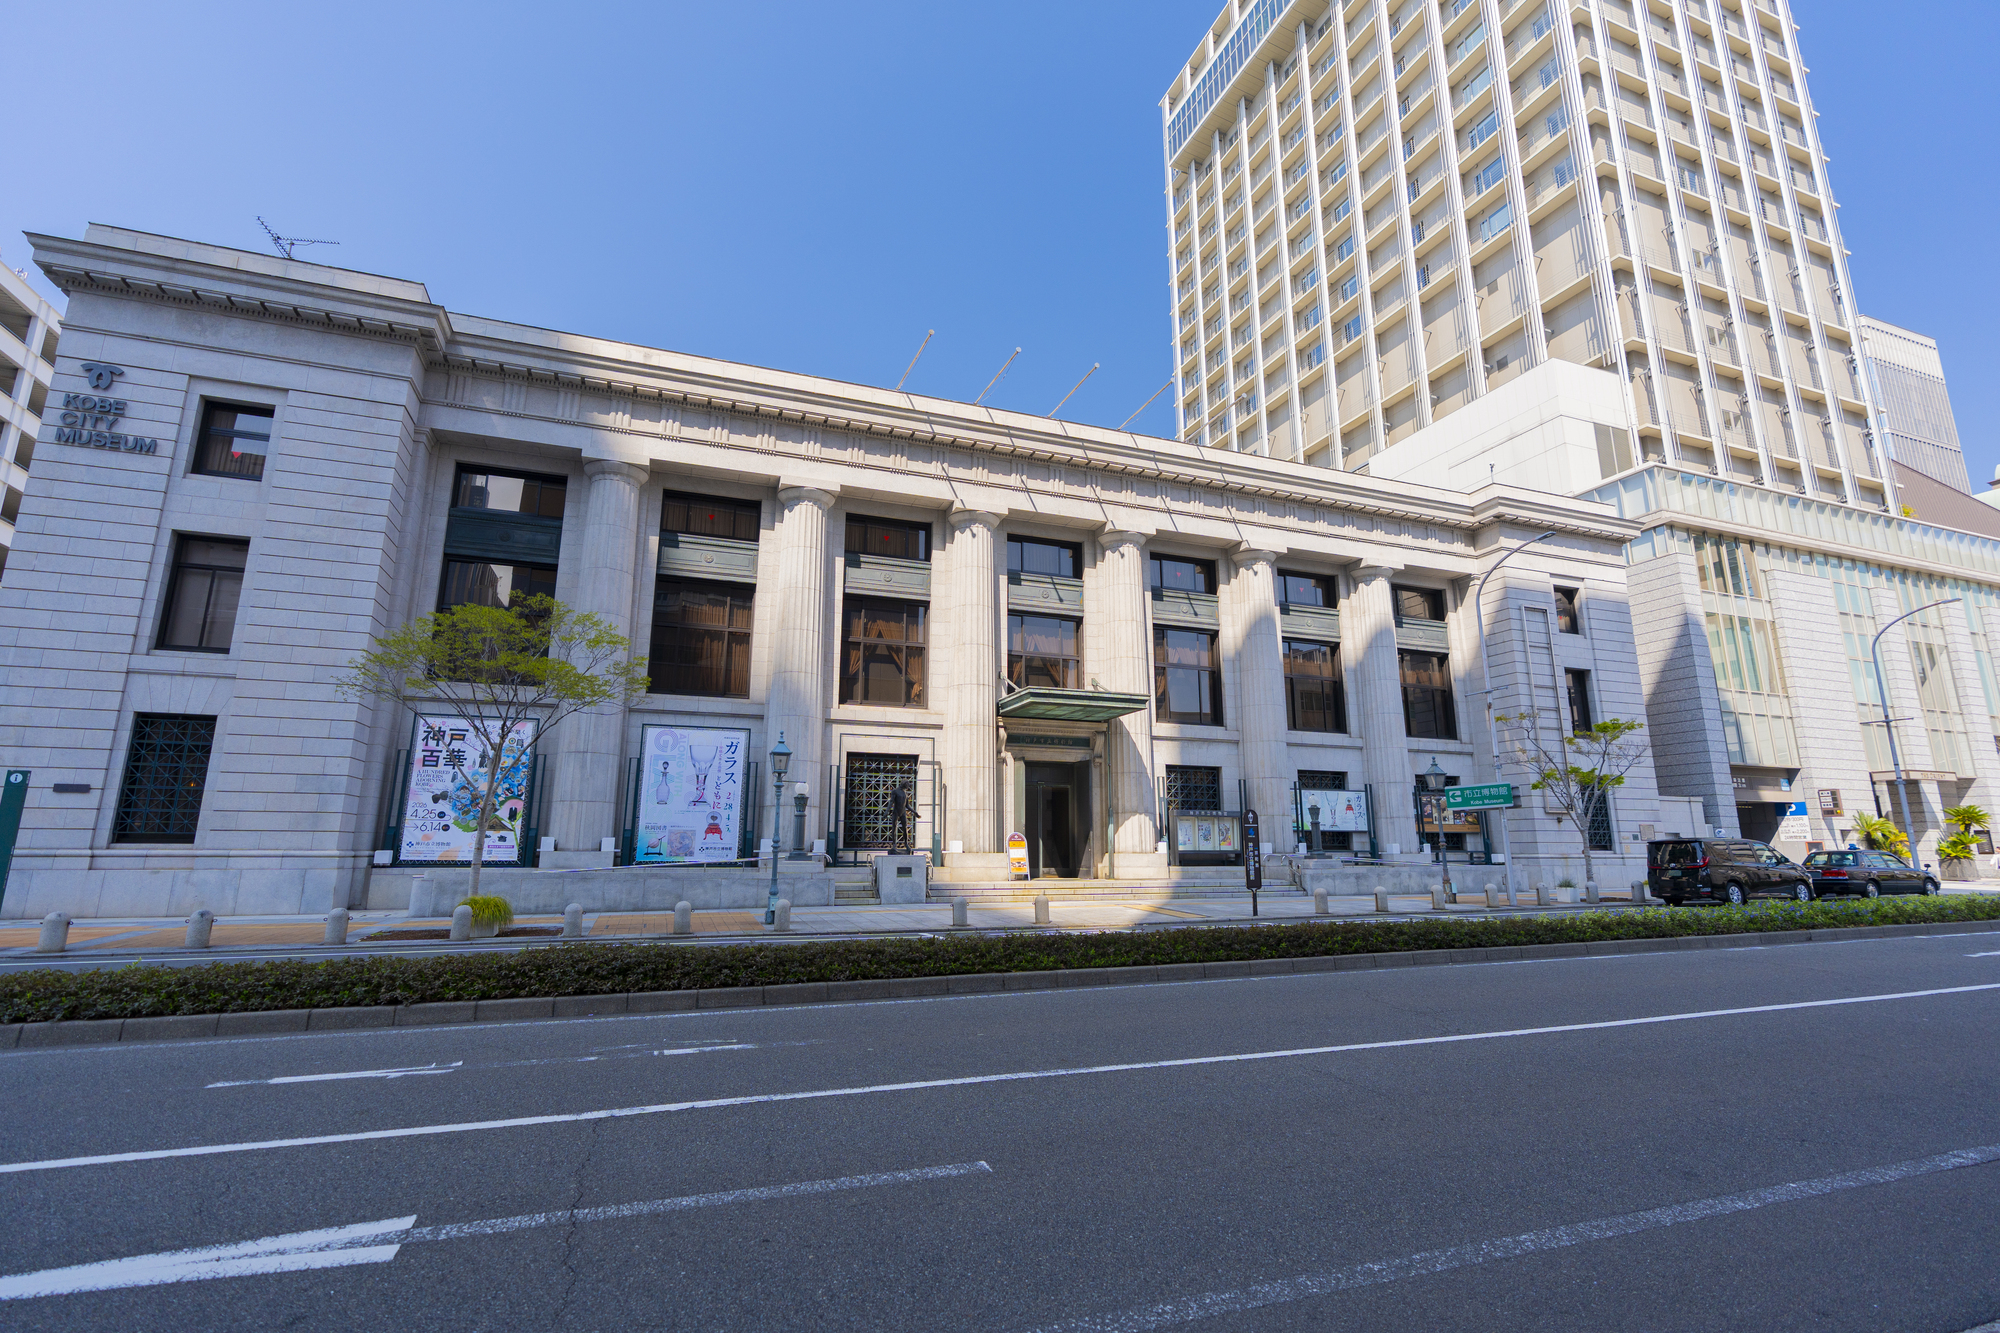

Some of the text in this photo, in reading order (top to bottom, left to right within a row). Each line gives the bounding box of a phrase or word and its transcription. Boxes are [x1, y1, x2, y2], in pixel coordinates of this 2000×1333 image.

[62, 393, 127, 415] KOBE
[59, 410, 119, 430] CITY
[54, 427, 157, 454] MUSEUM
[422, 726, 469, 747] 神戸
[421, 748, 467, 769] 百華
[674, 732, 687, 797] ALONG WITH
[722, 741, 740, 785] ガラス
[1464, 787, 1508, 797] 市立博物館
[410, 809, 436, 819] 4.25
[1785, 804, 1796, 815] P
[420, 822, 441, 831] 6.14
